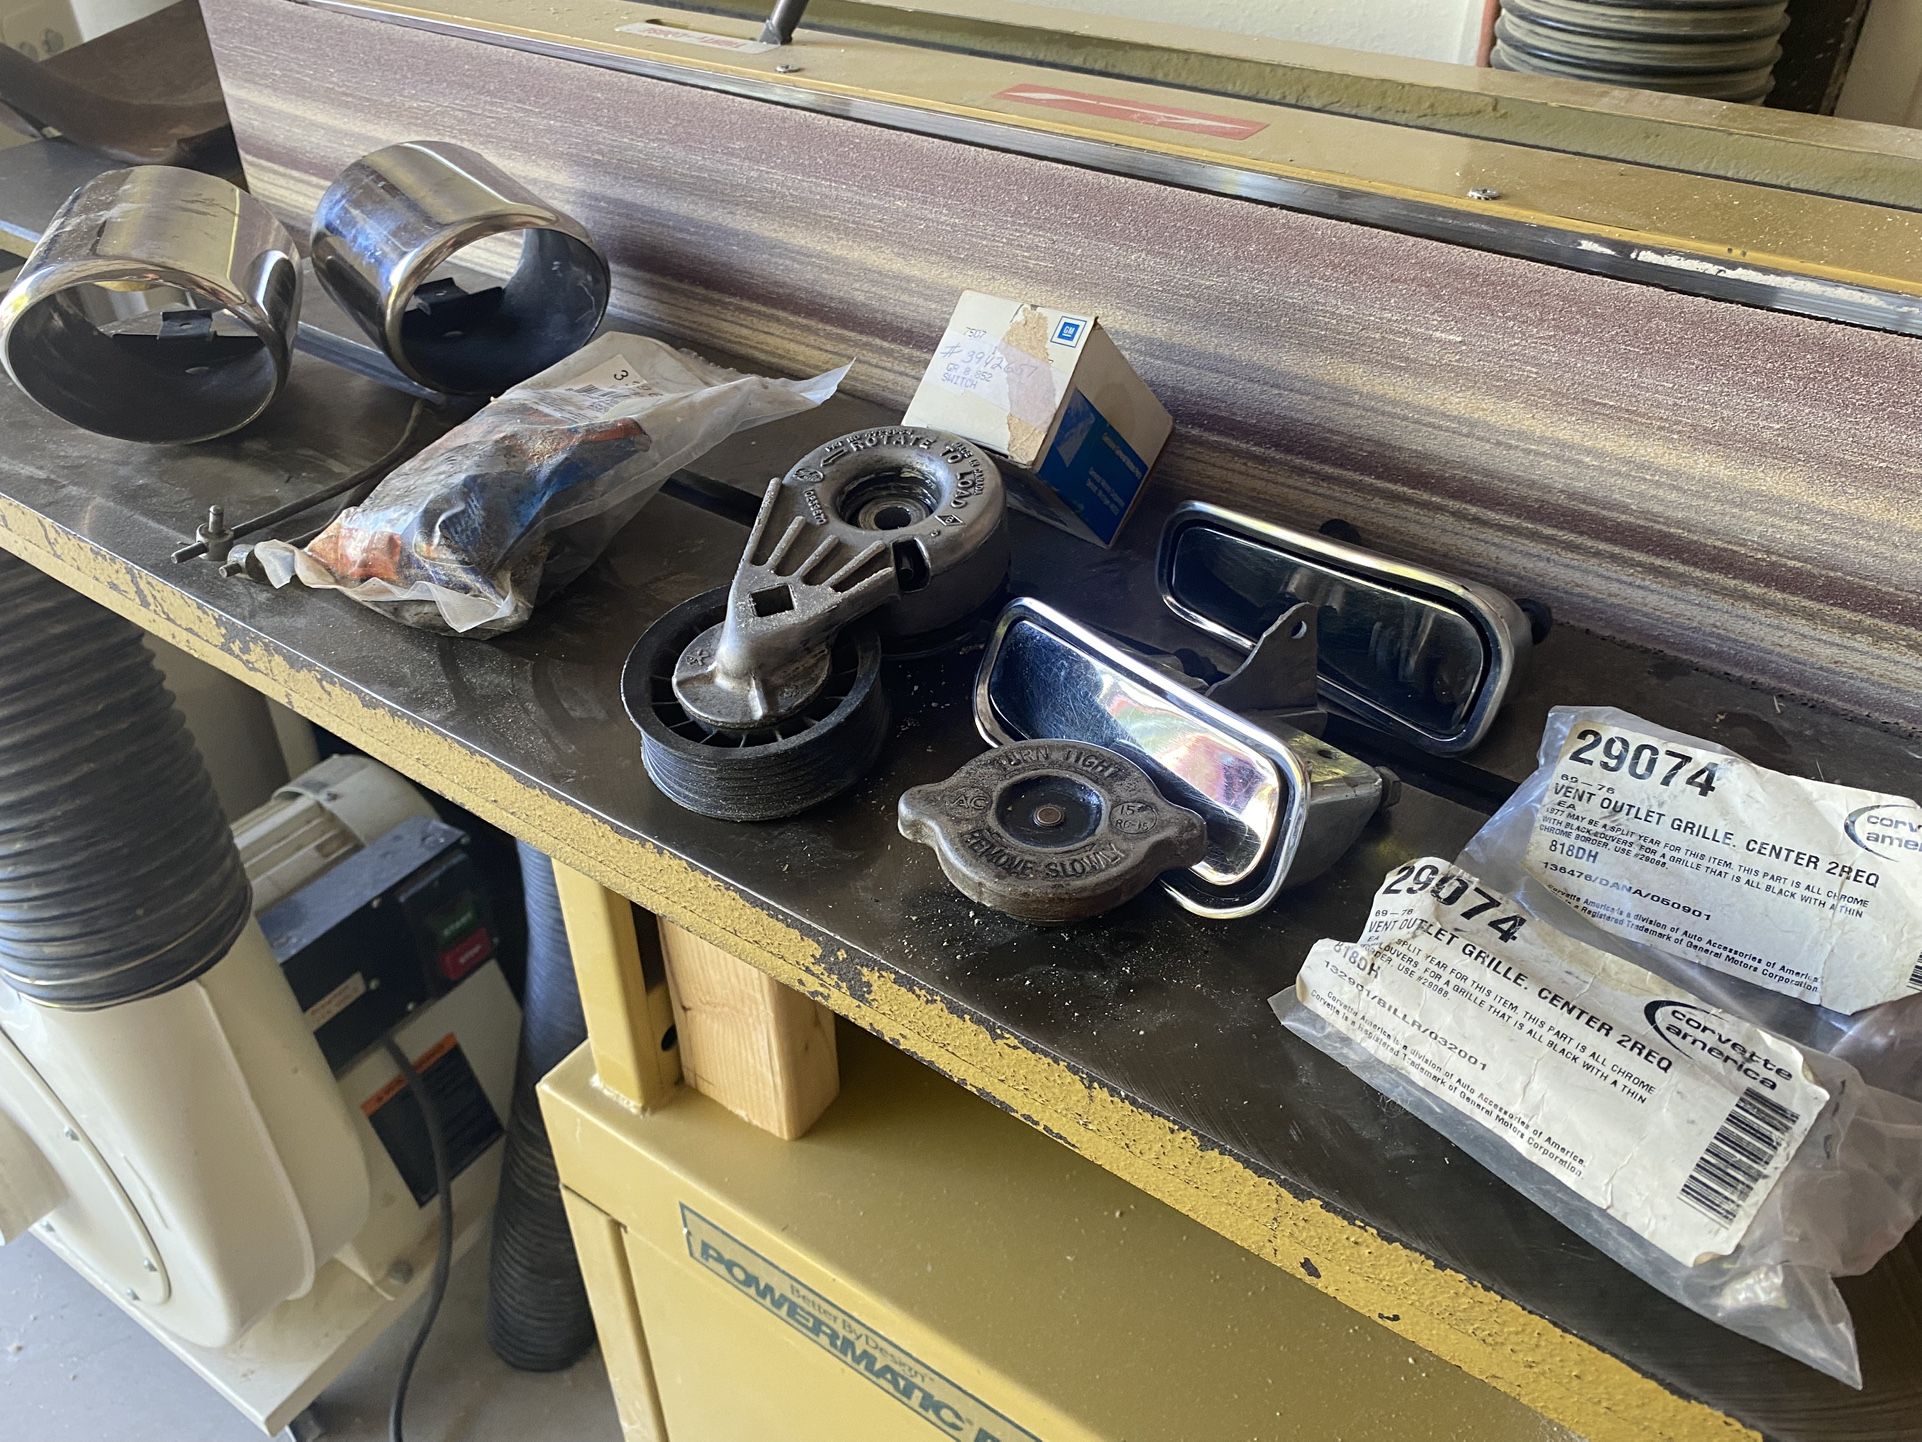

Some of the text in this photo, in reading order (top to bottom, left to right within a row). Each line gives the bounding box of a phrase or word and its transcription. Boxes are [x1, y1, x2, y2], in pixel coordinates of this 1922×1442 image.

[1063, 324, 1075, 335] GM
[941, 373, 978, 390] SWITCH
[849, 433, 937, 453] ROTATE
[940, 445, 963, 465] TO
[950, 470, 974, 509] LOAD
[1568, 728, 1720, 798] 29074
[951, 792, 987, 811] AC
[1552, 782, 1596, 805] VENT
[1598, 796, 1666, 826] OUTLET
[1744, 837, 1820, 870] CENTER
[1824, 860, 1880, 888] 2REQ
[1555, 799, 1577, 811] EA
[1538, 822, 1572, 839] CHROME
[1613, 845, 1632, 857] USE
[1541, 815, 1563, 827] WITH
[1564, 821, 1592, 836] BLACK
[1638, 844, 1658, 856] FOR
[1658, 851, 1666, 860] A
[1668, 854, 1702, 871] GRILLE
[1703, 865, 1729, 879] THAT
[1730, 873, 1742, 883] IS
[1743, 877, 1761, 890] ALL
[1764, 883, 1797, 900] BLACK
[1799, 893, 1827, 908] WITH
[1828, 902, 1836, 911] A
[1838, 904, 1864, 918] THIN
[1547, 838, 1599, 864] 818DH
[1565, 812, 1585, 823] MAY
[1586, 818, 1600, 828] BE
[1600, 822, 1608, 830] A
[1608, 825, 1634, 838] SPLIT
[1637, 833, 1661, 848] YEAR
[1662, 841, 1681, 854] FOR
[1683, 848, 1706, 861] THIS
[1737, 863, 1759, 877] THIS
[1761, 871, 1788, 885] PART
[1789, 879, 1801, 889] IS
[1803, 883, 1822, 896] ALL
[1825, 889, 1870, 908] CHROME
[1382, 864, 1527, 943] 29074
[1332, 941, 1381, 979] 818DH
[1396, 962, 1416, 979] USE
[1579, 905, 1625, 926] Registered
[1625, 919, 1671, 942] Trademark
[1672, 936, 1684, 946] of
[1684, 939, 1723, 959] General
[1723, 953, 1759, 973] Motors
[1632, 912, 1668, 931] division
[1668, 925, 1679, 934] of
[1680, 928, 1703, 943] Auto
[1704, 937, 1763, 965] Accessories
[1764, 959, 1776, 969] of
[1368, 920, 1398, 932] VENT
[1398, 918, 1459, 946] OUTLET
[1536, 986, 1614, 1038] CENTER
[1615, 1033, 1673, 1073] 2REQ
[1394, 937, 1422, 956] SPLIT
[1448, 967, 1469, 984] FOR
[1469, 979, 1493, 997] THIS
[1521, 1010, 1546, 1029] THIS
[1546, 1024, 1574, 1045] PART
[1574, 1041, 1587, 1054] IS
[1587, 1050, 1607, 1067] ALL
[1609, 1063, 1656, 1095] CHROME
[1309, 988, 1341, 1016] Corvette
[1340, 1012, 1349, 1022] is
[1349, 1019, 1356, 1027] a
[1446, 1083, 1458, 1094] of
[1458, 1089, 1493, 1117] General
[1493, 1113, 1525, 1140] Motors
[1422, 966, 1443, 982] FOR
[1442, 978, 1451, 988] A
[1451, 983, 1486, 1008] GRILLE
[1486, 1004, 1512, 1023] THAT
[1512, 1019, 1525, 1031] IS
[1525, 1027, 1543, 1044] ALL
[1545, 1039, 1579, 1064] BLACK
[1581, 1060, 1609, 1082] WITH
[1608, 1078, 1618, 1088] A
[1620, 1083, 1647, 1104] THIN
[1664, 1022, 1778, 1091] america
[1669, 1008, 1793, 1081] corvette
[1326, 990, 1359, 1017] Corvette
[1400, 1043, 1408, 1051] a
[1409, 1048, 1442, 1073] division
[1443, 1070, 1454, 1080] of
[1454, 1076, 1476, 1095] Auto
[1476, 1091, 1530, 1130] Accessories
[1531, 1127, 1543, 1139] of
[1543, 1135, 1585, 1166] America.
[700, 1239, 966, 1432] POWERMATIC
[790, 1283, 926, 1383] Better By Design
